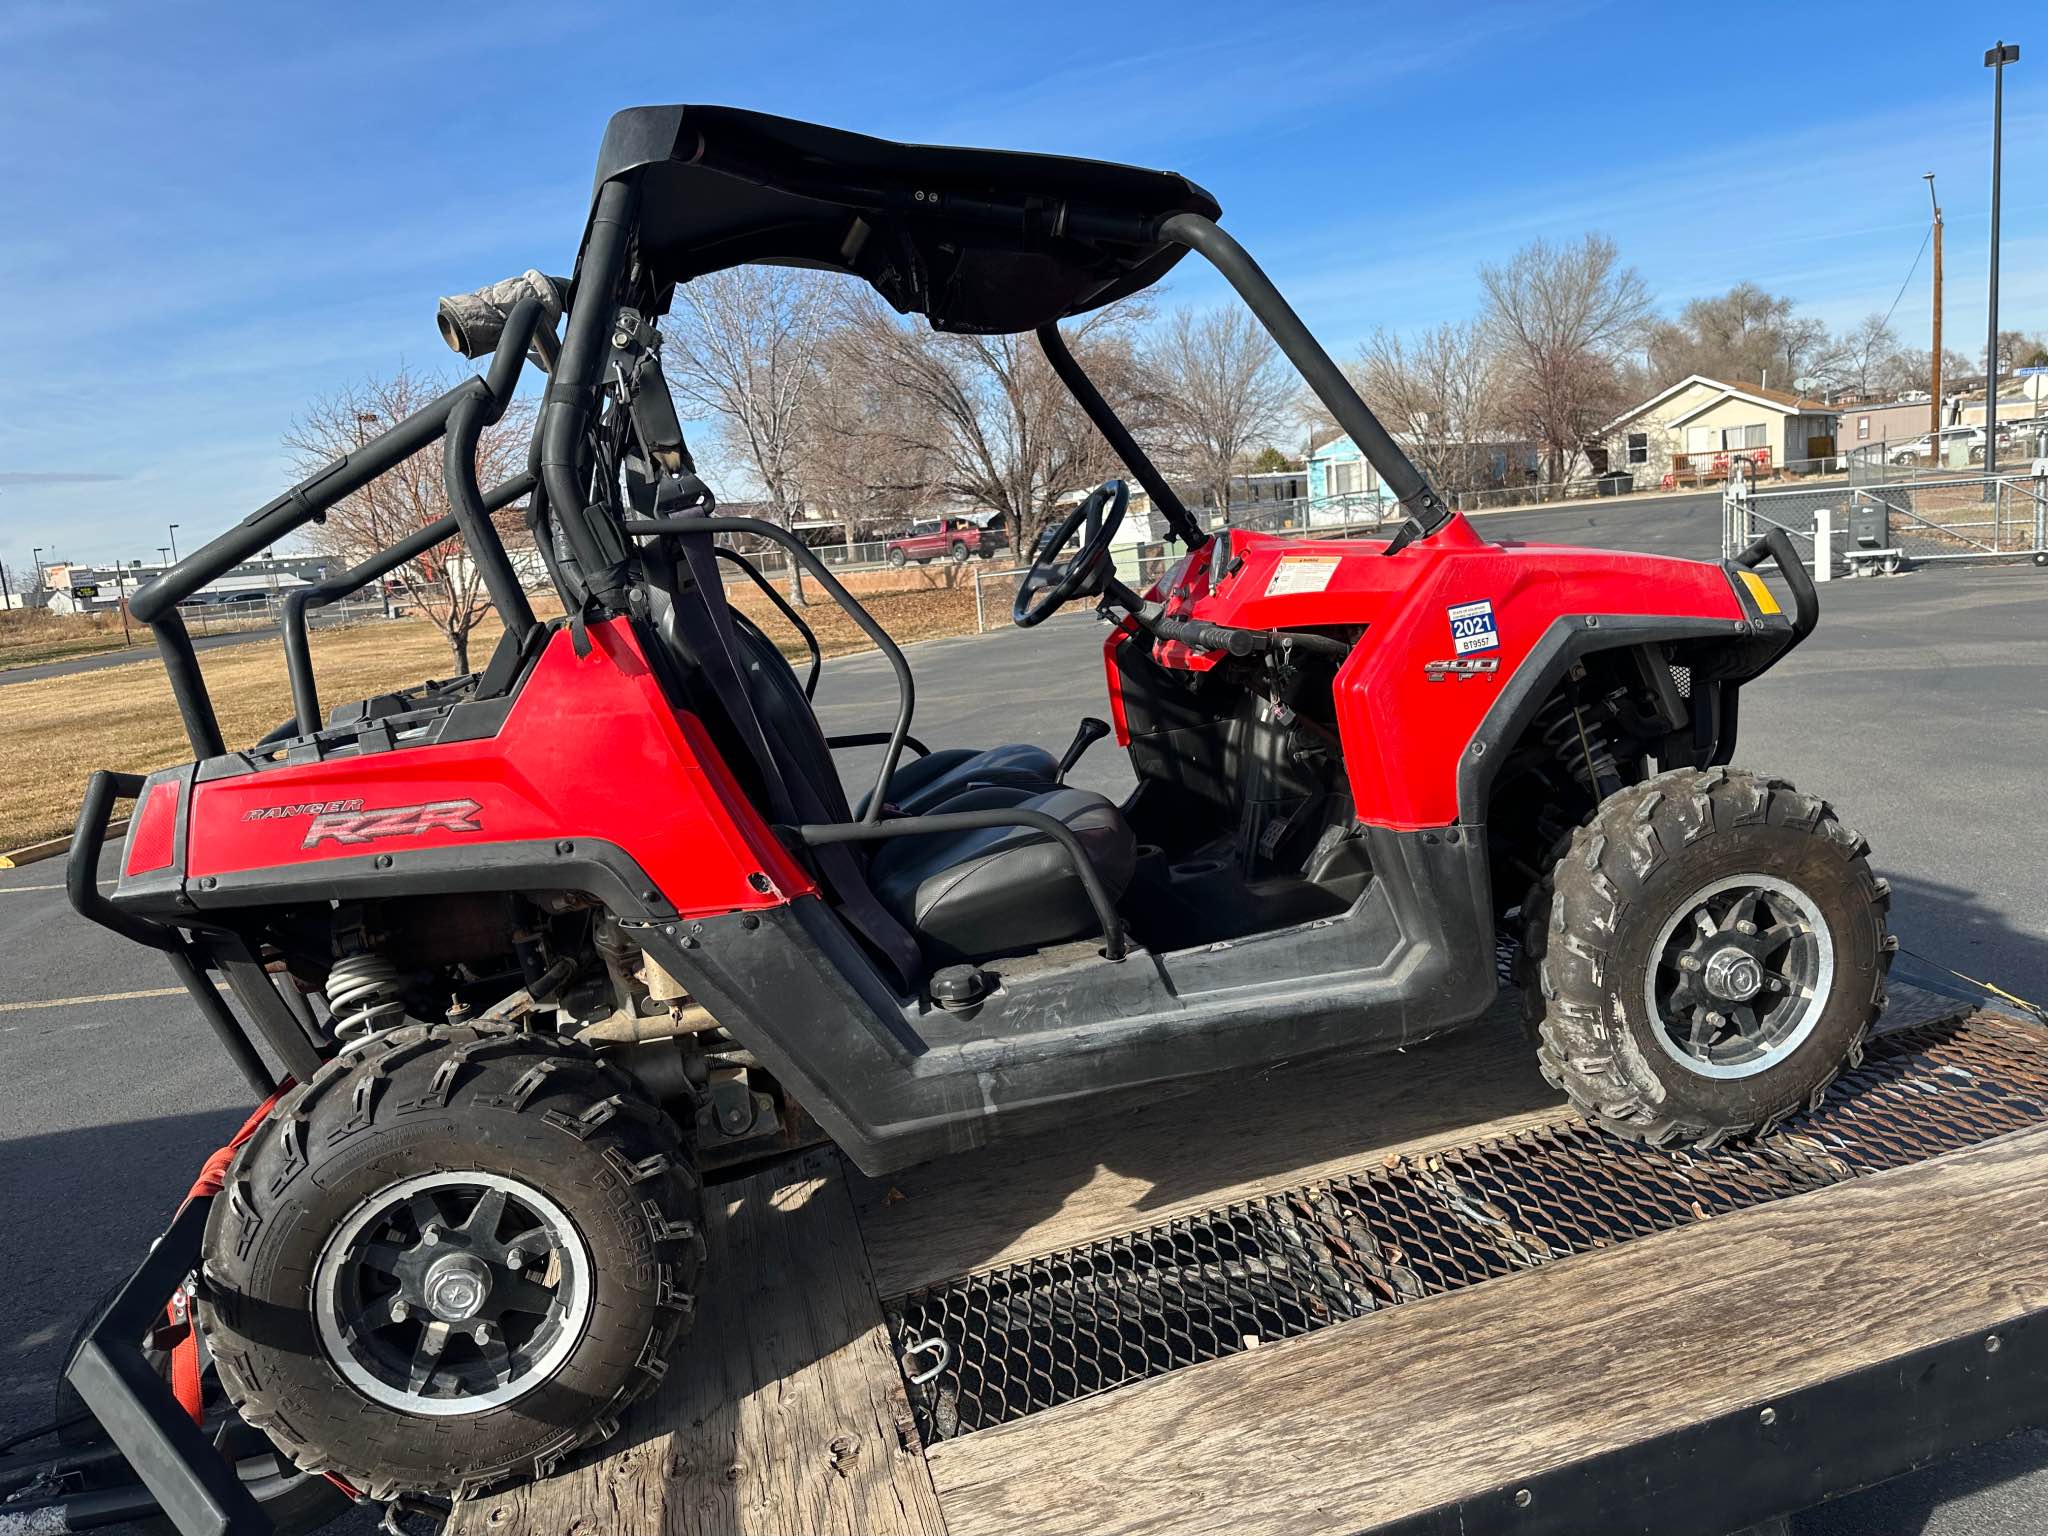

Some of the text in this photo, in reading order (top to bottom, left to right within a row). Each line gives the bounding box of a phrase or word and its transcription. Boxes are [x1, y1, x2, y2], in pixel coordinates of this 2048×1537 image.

[1453, 615, 1492, 638] 2021
[1463, 637, 1490, 650] BT9557
[1428, 672, 1492, 682] EFI
[242, 798, 365, 822] RANGER
[301, 798, 483, 850] RZR
[591, 1167, 654, 1281] POLARIS
